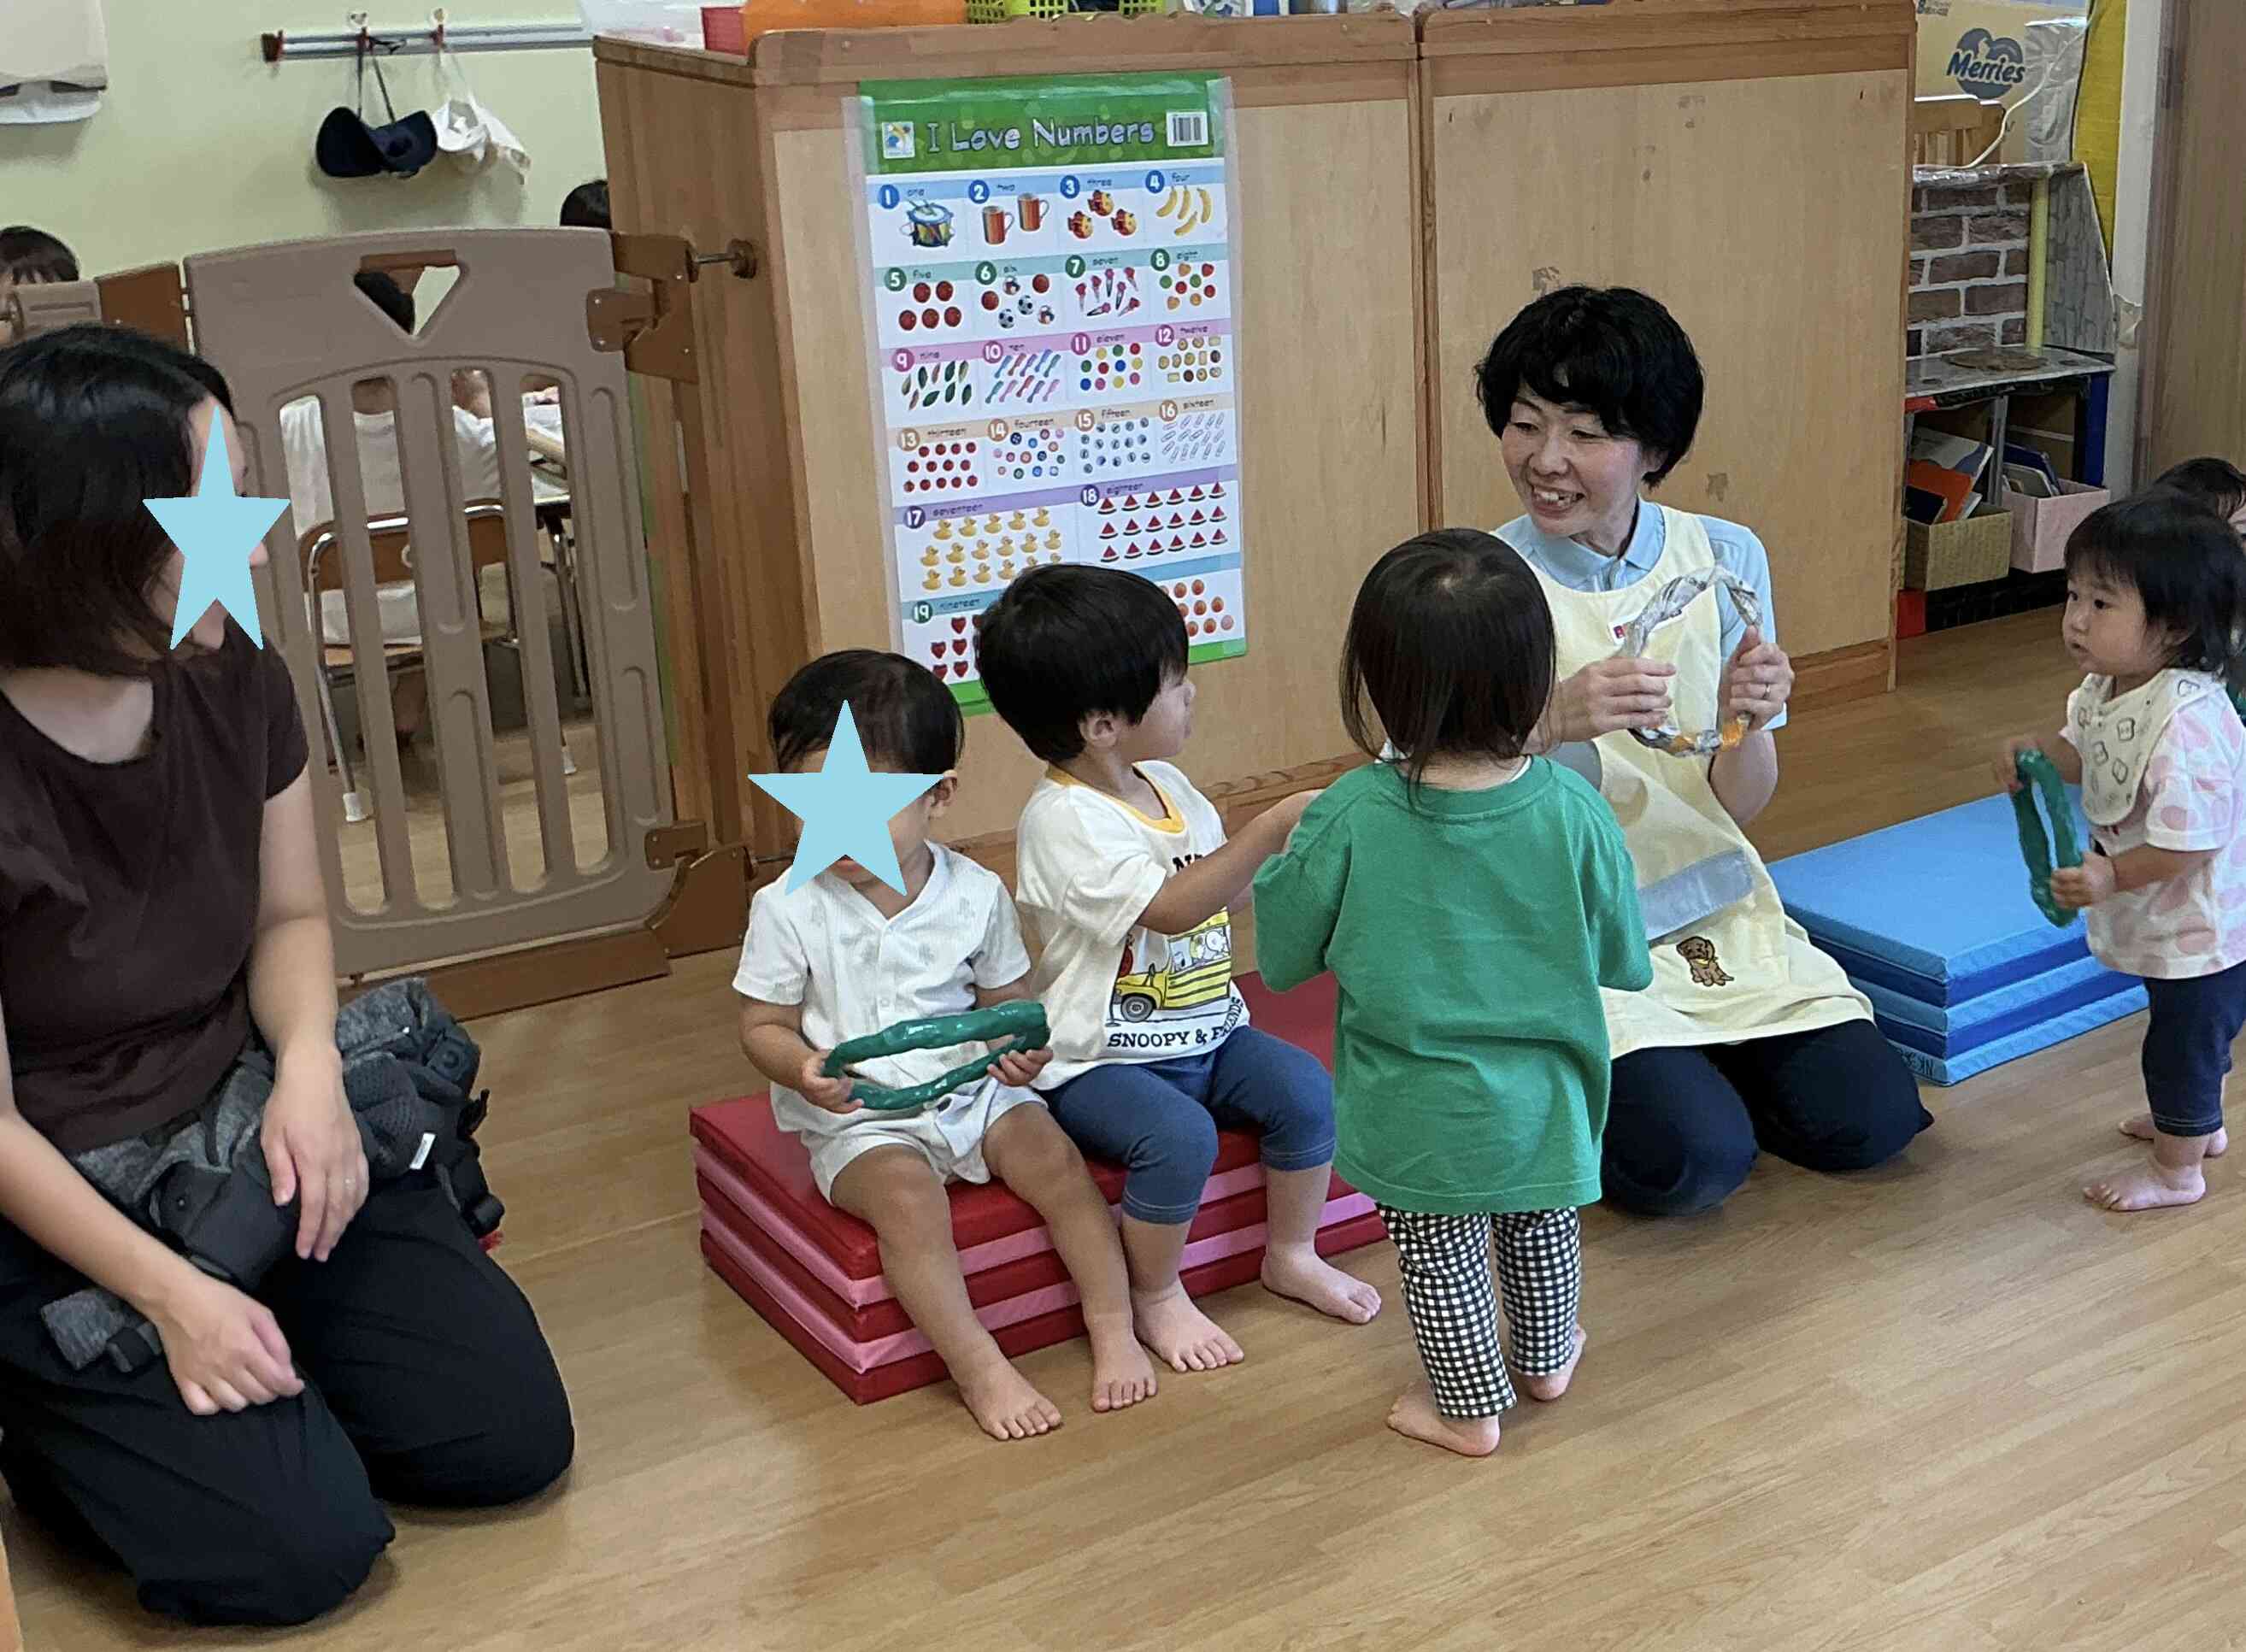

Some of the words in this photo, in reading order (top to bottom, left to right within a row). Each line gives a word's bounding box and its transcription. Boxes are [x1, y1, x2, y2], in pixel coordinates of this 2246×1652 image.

[1946, 51, 2026, 84] Merries
[926, 121, 941, 154] I
[950, 121, 1022, 152] Love
[1032, 116, 1155, 148] Numbers
[1107, 1030, 1191, 1048] SNOOPY
[1194, 1028, 1208, 1045] &
